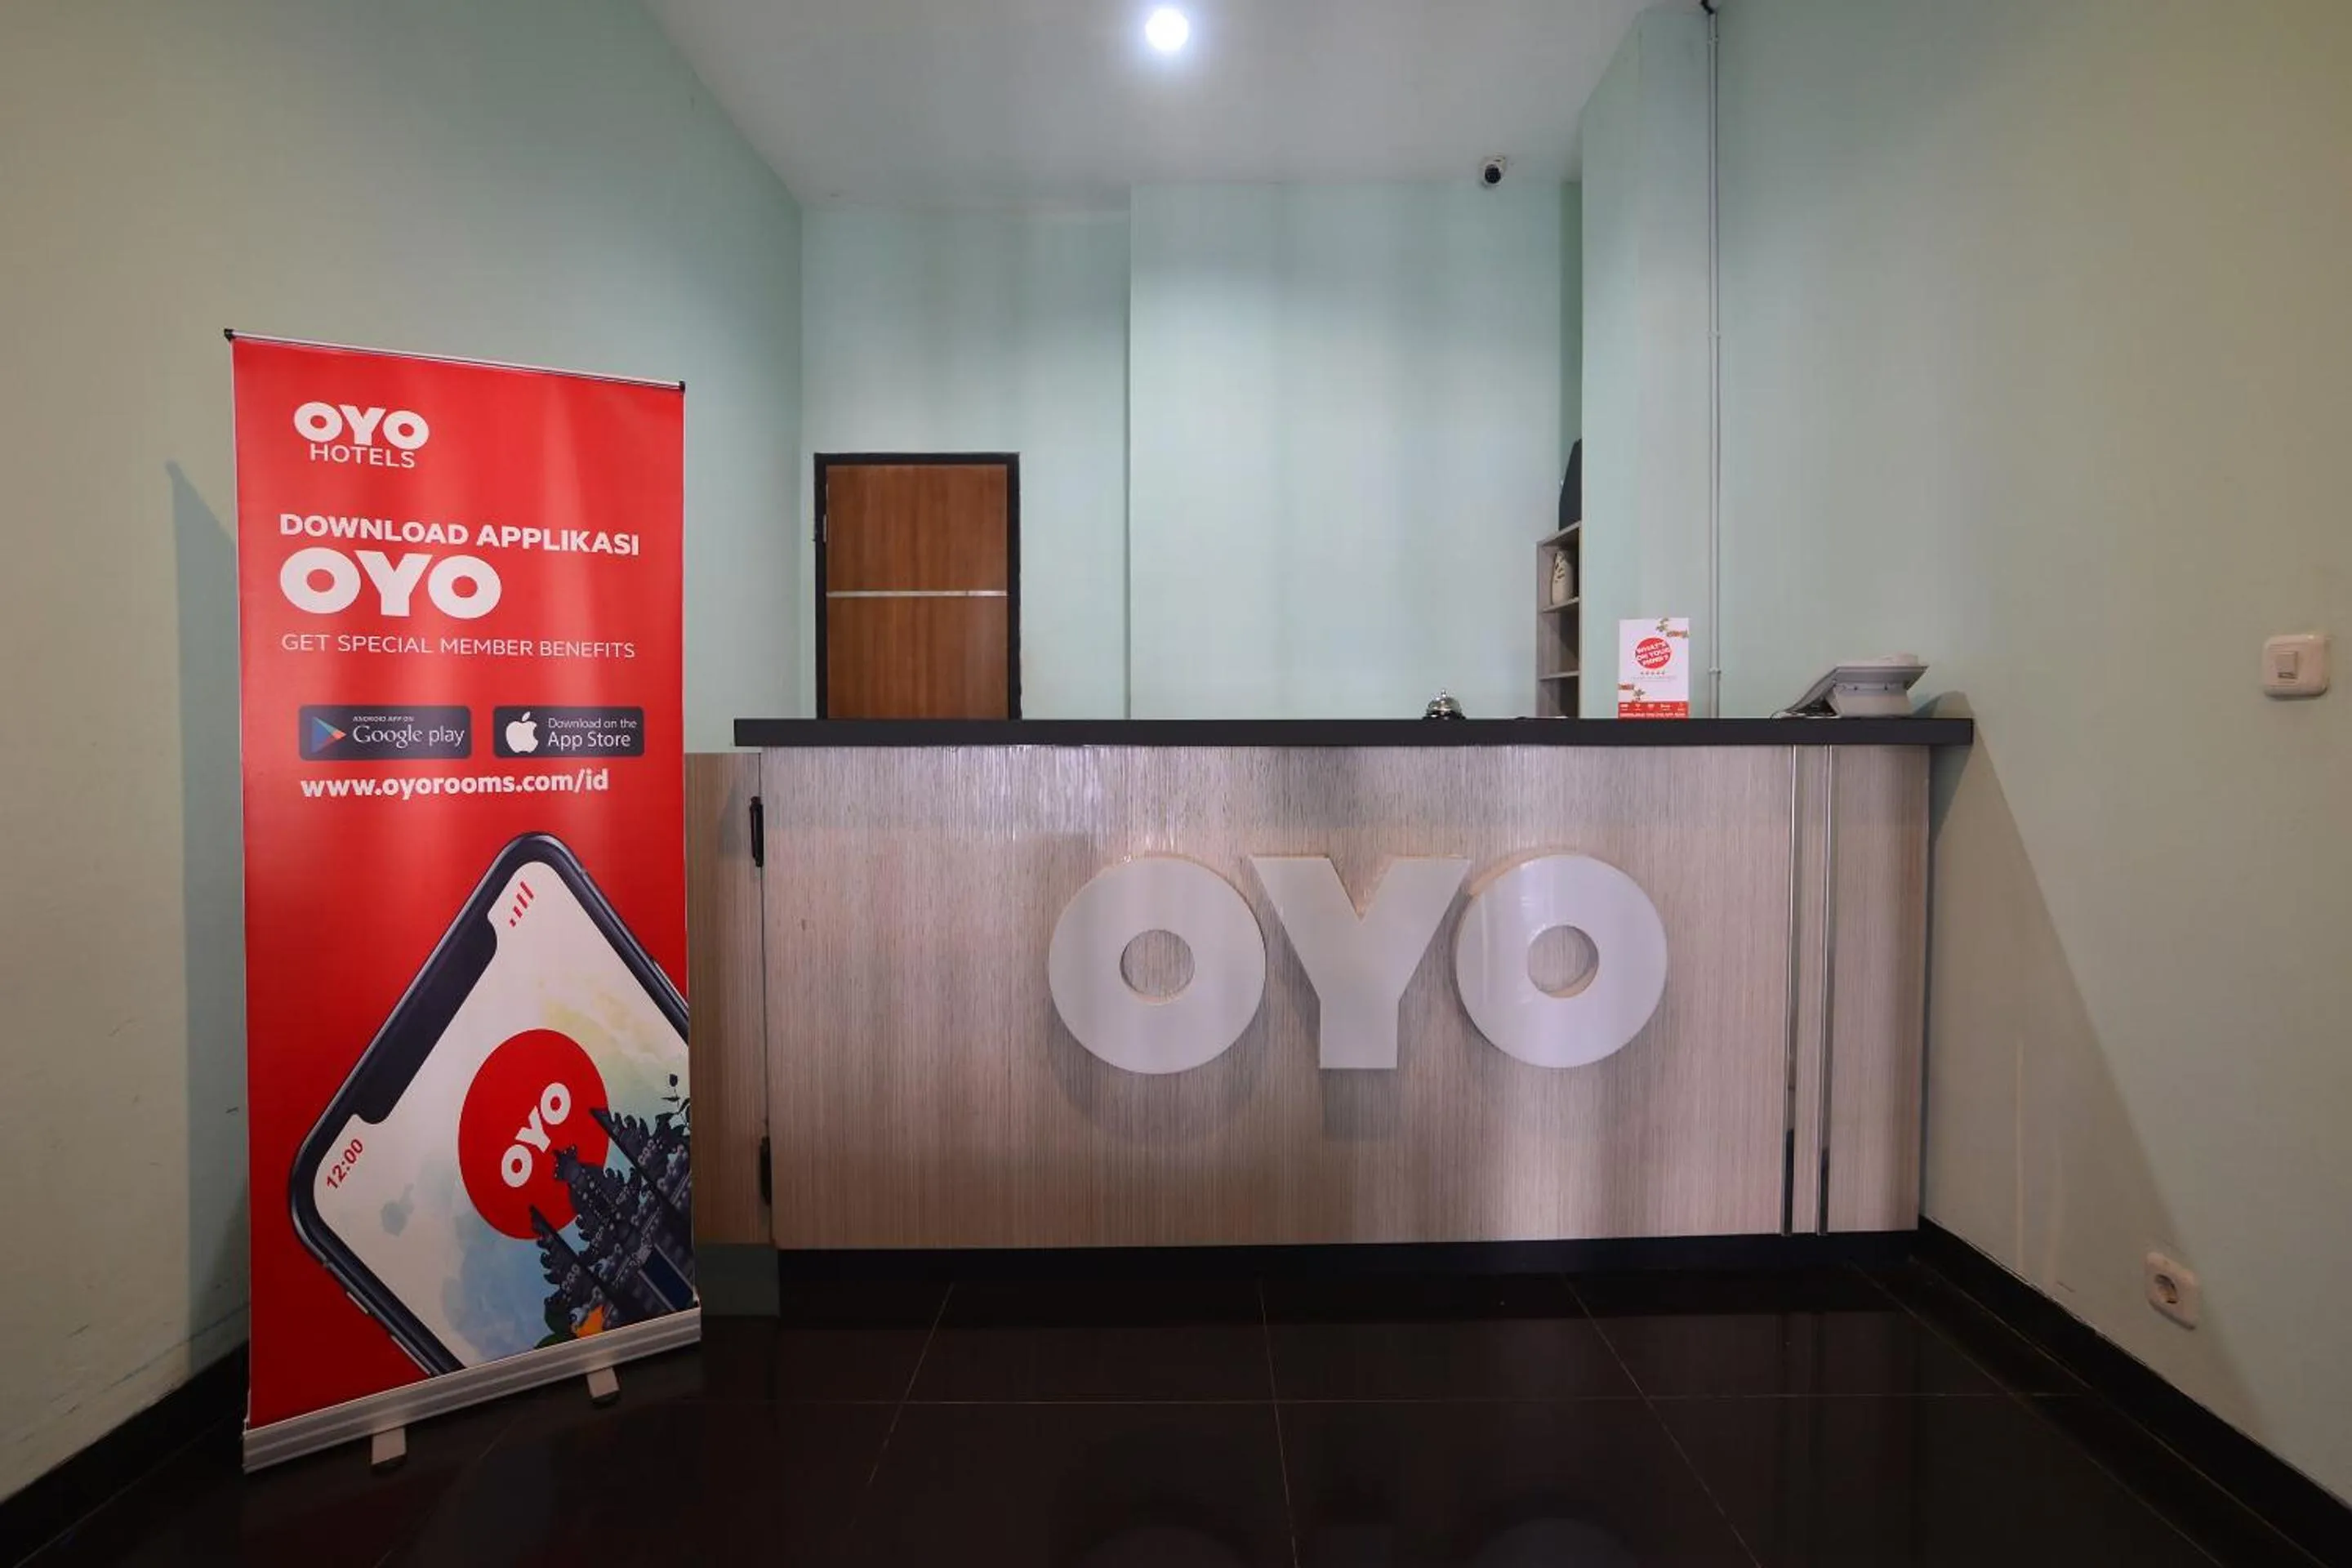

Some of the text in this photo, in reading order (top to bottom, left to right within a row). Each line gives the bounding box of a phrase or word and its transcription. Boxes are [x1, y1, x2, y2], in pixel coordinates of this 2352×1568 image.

[294, 401, 430, 450] OYO
[310, 443, 416, 469] HOTELS
[279, 513, 639, 556] DOWNLOAD APPLIKASI
[279, 546, 502, 619] OYO
[281, 633, 635, 659] GET SPECIAL MEMBER BENEFITS
[352, 724, 465, 749] Google play
[547, 730, 631, 751] App Store
[548, 717, 638, 728] Download on the
[300, 766, 609, 801] www.oyorooms.com/id
[1049, 853, 1668, 1075] OYO
[501, 1082, 571, 1188] OYO
[327, 1138, 363, 1189] 12:00
